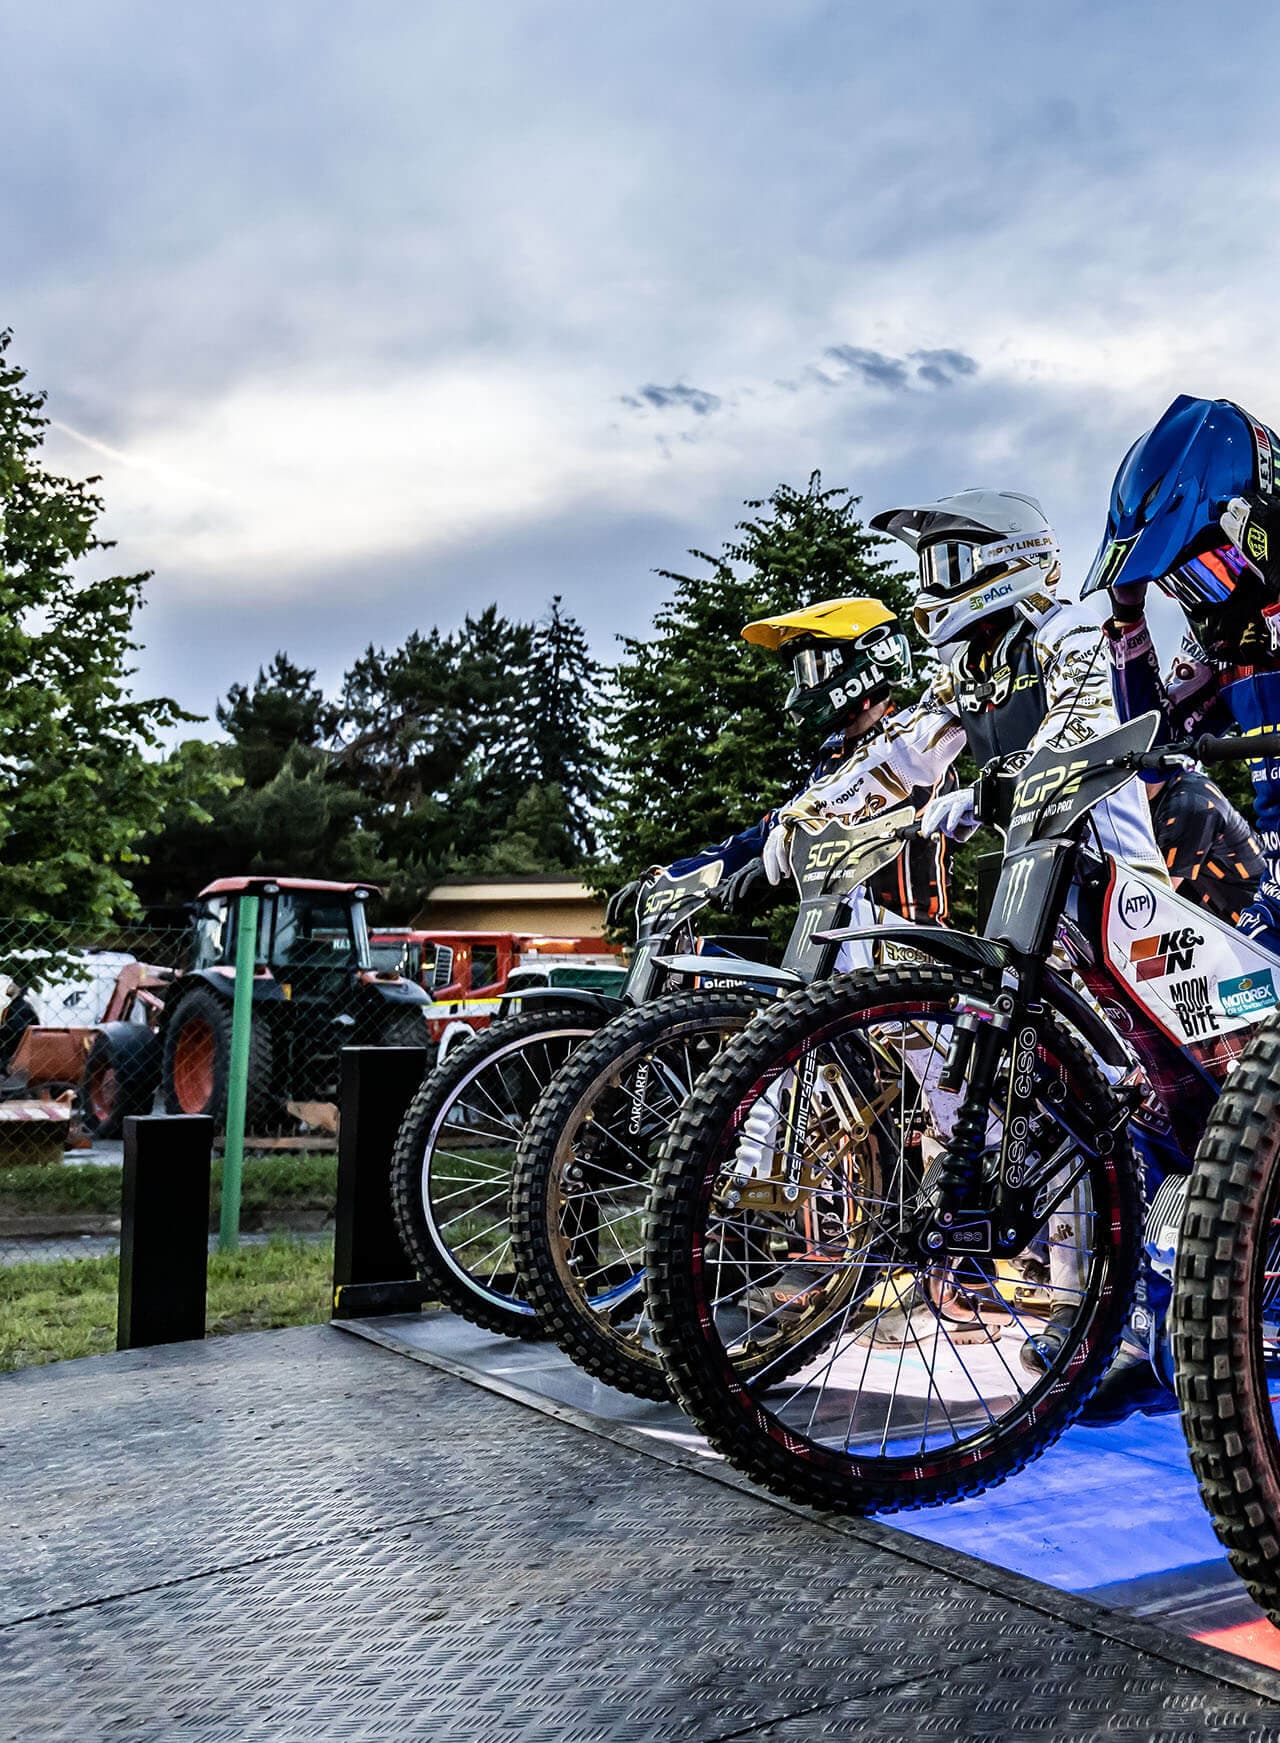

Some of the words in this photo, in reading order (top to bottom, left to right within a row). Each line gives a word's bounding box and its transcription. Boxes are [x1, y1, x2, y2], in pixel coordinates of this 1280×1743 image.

[1124, 894, 1151, 915] ATPI
[1169, 976, 1210, 1015] MOON
[1222, 985, 1273, 1008] MOTOREX
[1176, 1003, 1220, 1038] BITE
